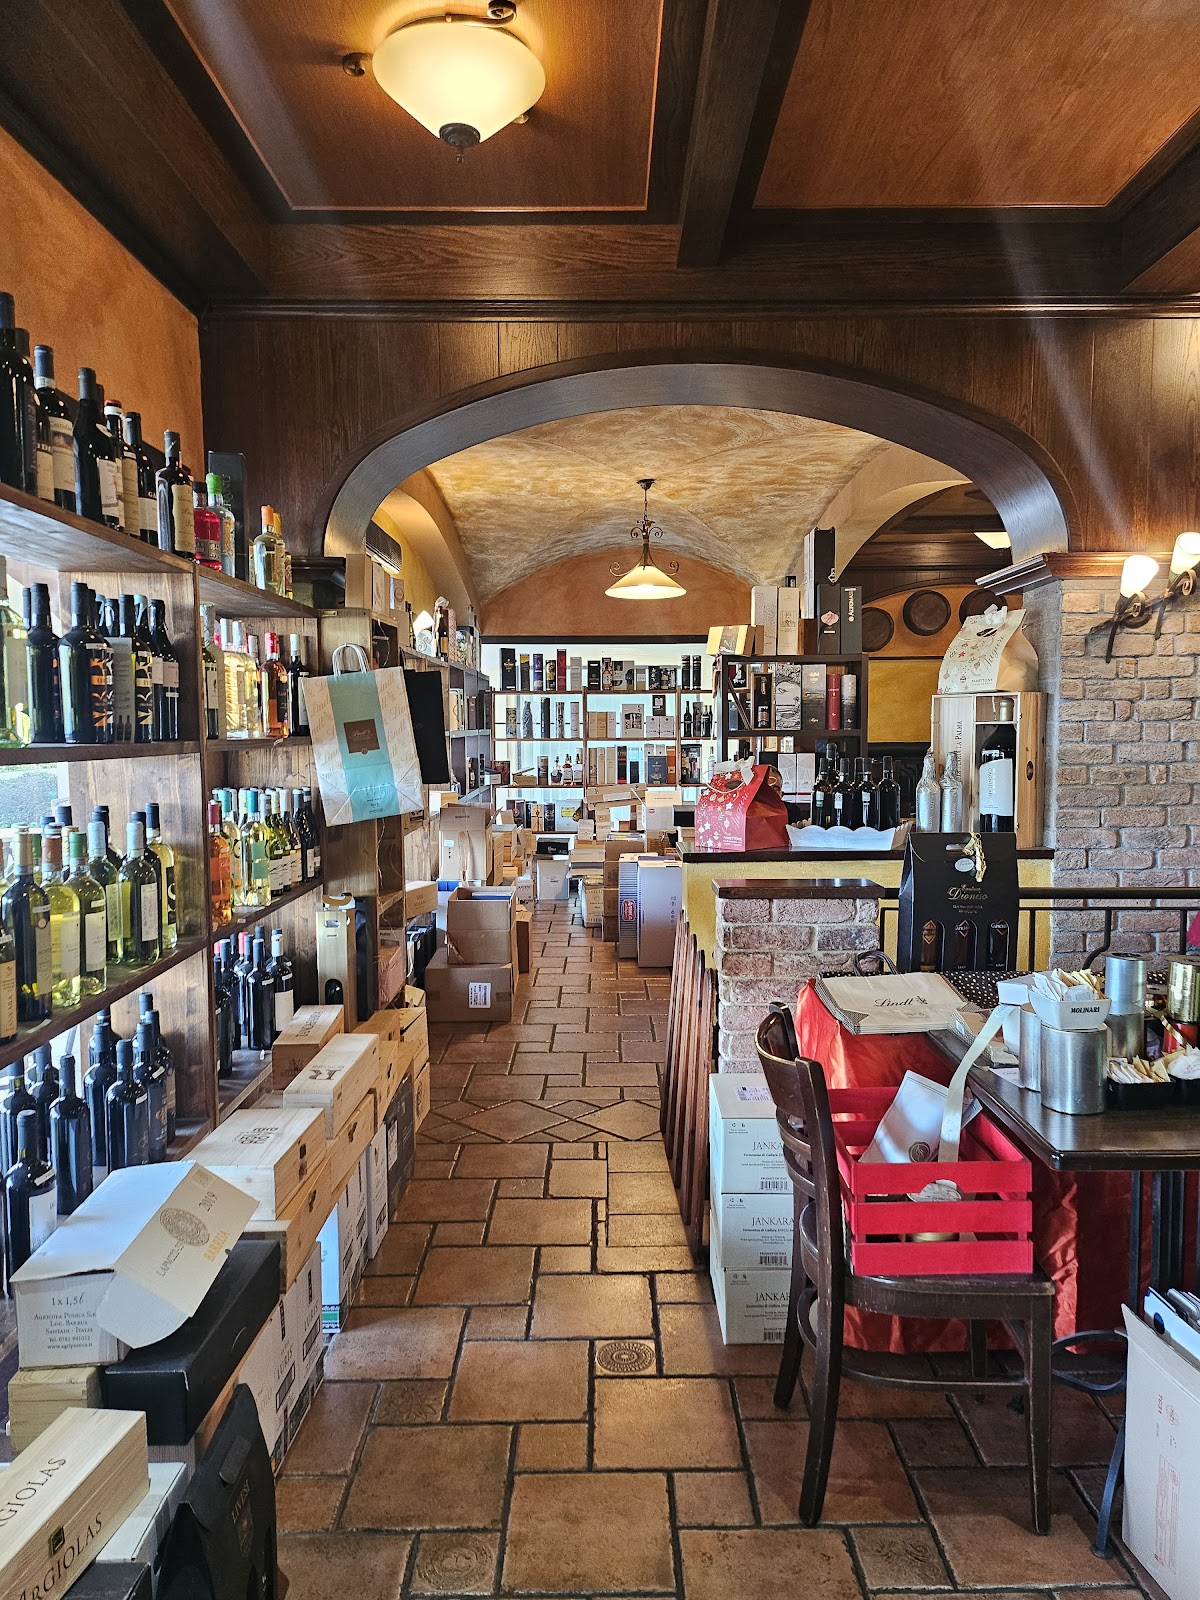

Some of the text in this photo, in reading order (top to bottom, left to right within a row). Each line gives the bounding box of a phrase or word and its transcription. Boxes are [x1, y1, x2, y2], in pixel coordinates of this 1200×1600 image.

[947, 886, 988, 900] Dioniso
[874, 998, 914, 1007] Lindt
[199, 1191, 217, 1212] 2019
[752, 1217, 794, 1226] JANKARA
[203, 1230, 230, 1262] BARRUA
[0, 1458, 66, 1527] GIOLAS
